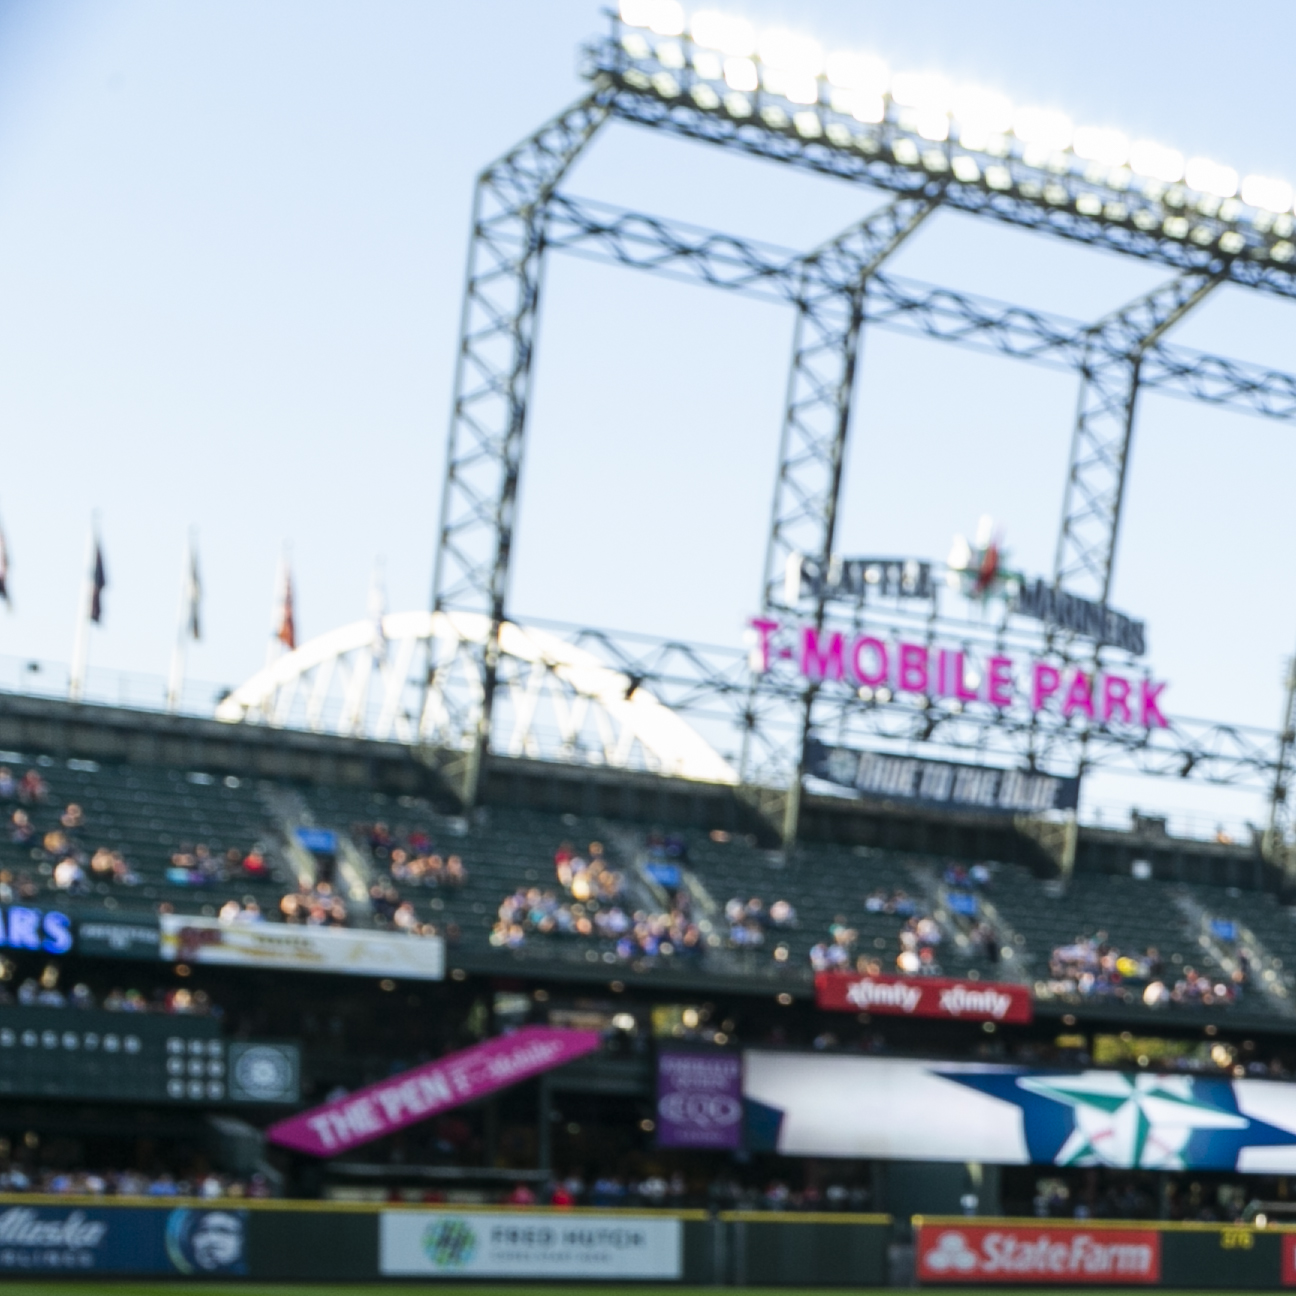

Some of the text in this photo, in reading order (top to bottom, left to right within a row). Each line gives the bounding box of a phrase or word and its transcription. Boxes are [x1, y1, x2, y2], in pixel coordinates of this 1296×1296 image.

[751, 619, 1170, 730] T-MOBILE PARK
[305, 1096, 385, 1150] THE
[374, 1068, 452, 1123] PEN
[490, 1225, 645, 1250] FRED HUTCH
